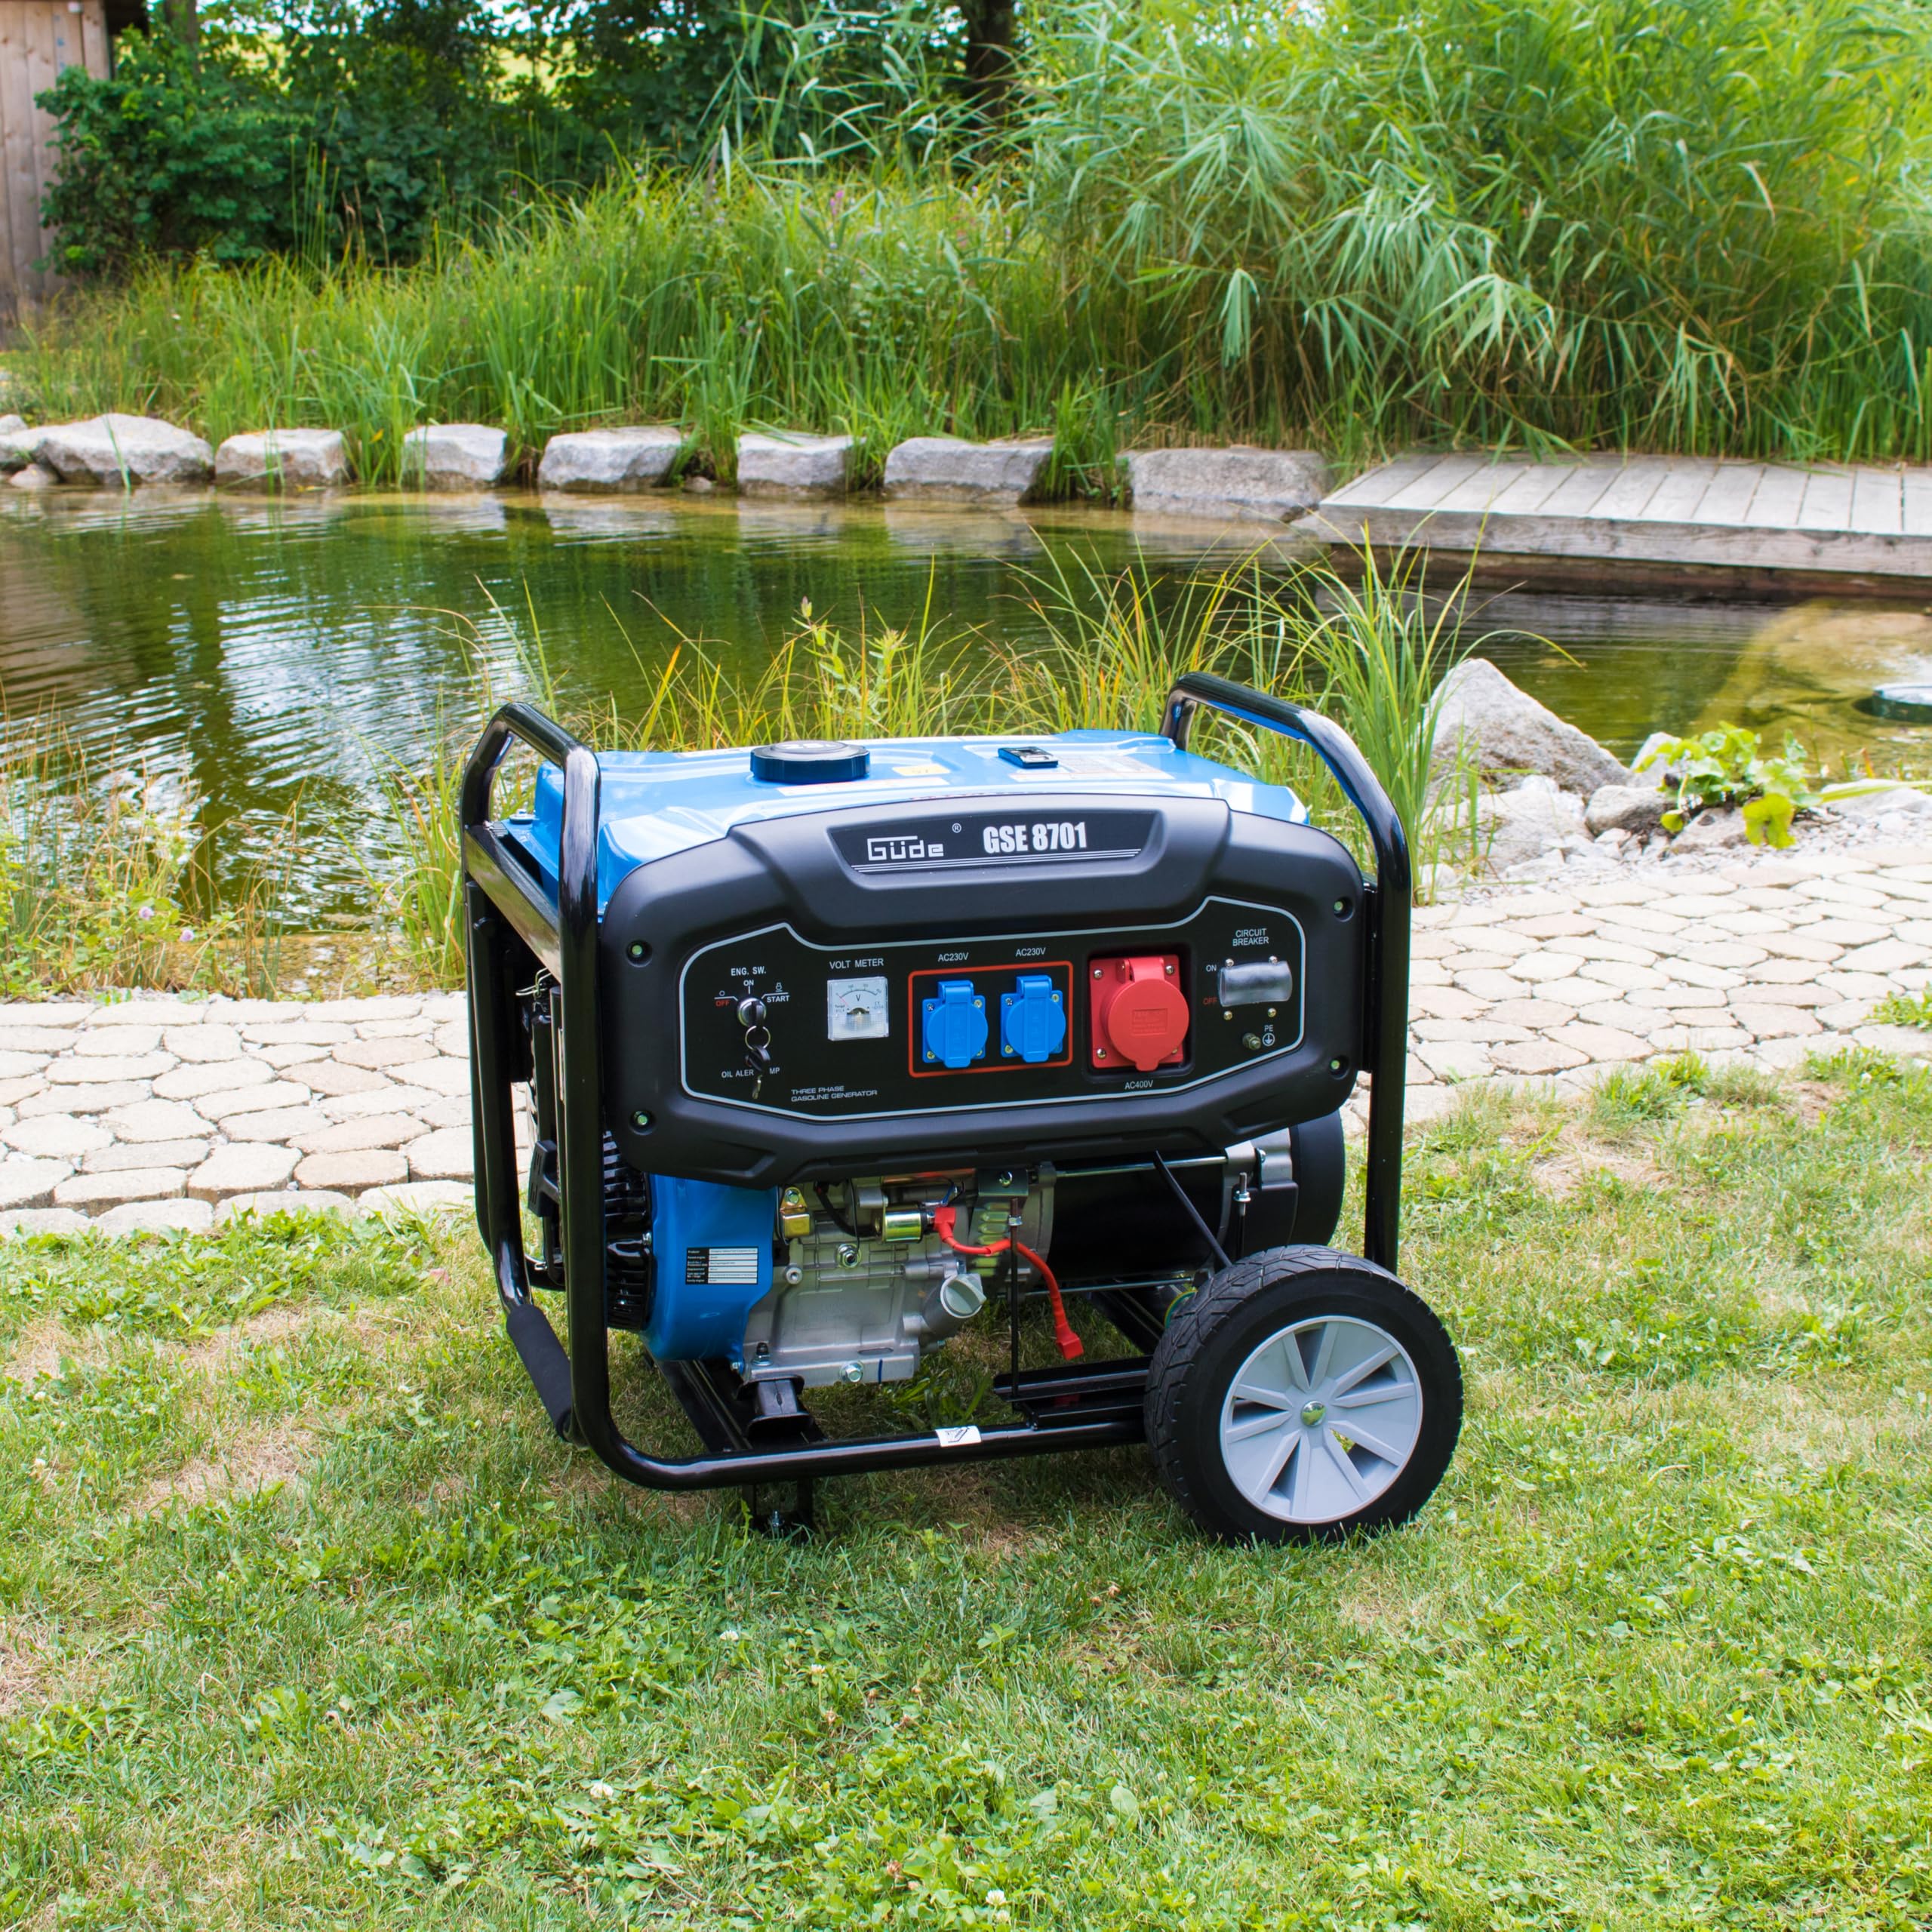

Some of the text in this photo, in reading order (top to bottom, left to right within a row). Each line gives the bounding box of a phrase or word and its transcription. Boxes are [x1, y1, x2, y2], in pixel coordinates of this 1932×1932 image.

[867, 835, 944, 861] Güde
[983, 825, 1029, 854] GSE
[1032, 821, 1088, 851] 8701
[1235, 928, 1267, 938] CIRCUIT
[1232, 936, 1269, 946] BREAKER
[937, 952, 969, 962] AC230V
[1015, 947, 1046, 957] AC230V
[829, 958, 884, 970] VOLT METER
[731, 965, 767, 977] ENG. SW.
[766, 995, 790, 1003] START
[1202, 997, 1217, 1005] OFF
[1264, 1024, 1274, 1032] PE
[721, 1070, 734, 1078] OIL
[735, 1069, 755, 1078] ALER
[1124, 1079, 1154, 1090] AC400V
[791, 1090, 878, 1103] GASOLINE GENERATOR
